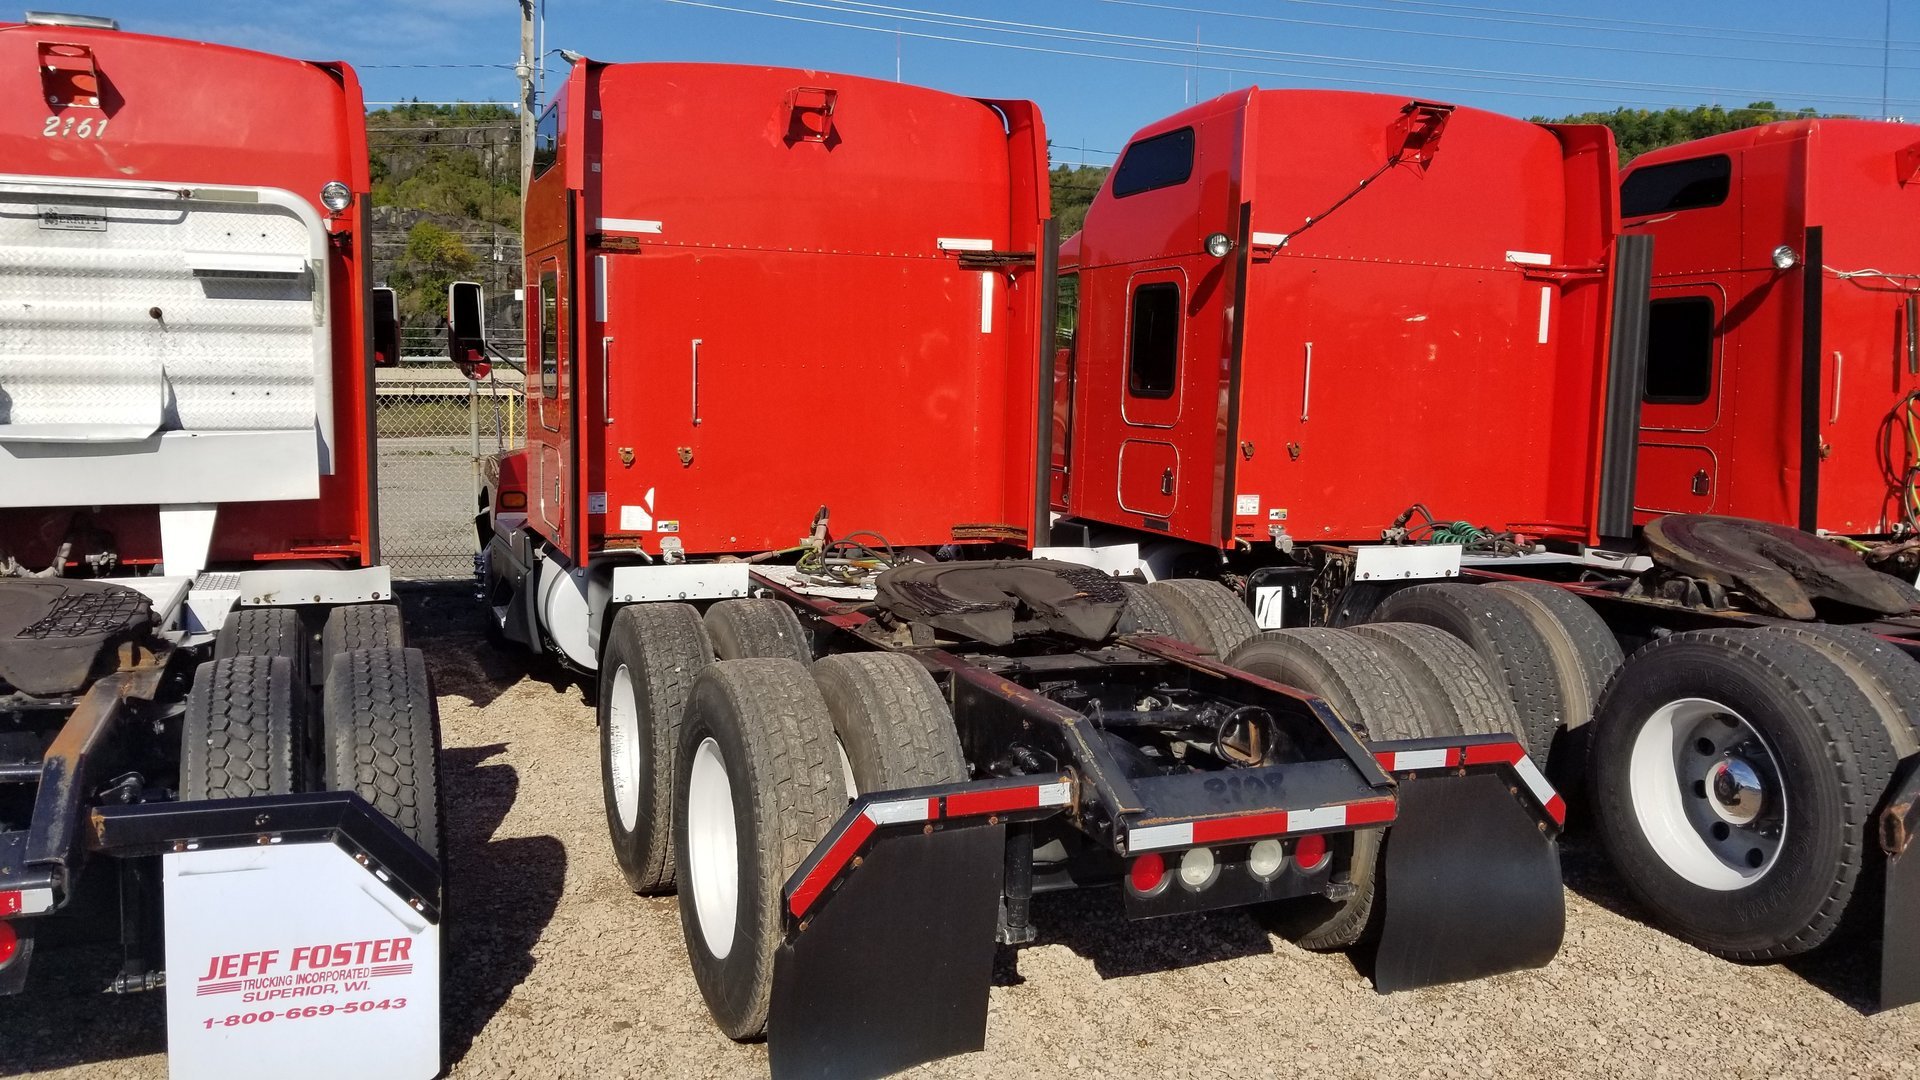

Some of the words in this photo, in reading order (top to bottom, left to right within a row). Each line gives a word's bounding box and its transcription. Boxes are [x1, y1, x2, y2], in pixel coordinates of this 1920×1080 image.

[43, 116, 108, 139] 2161
[1734, 833, 1810, 922] OKOHAMA
[198, 949, 279, 982] JEFF
[289, 937, 413, 972] FOSTER
[242, 973, 293, 991] TRUCKING
[295, 967, 370, 985] INCORPORATED
[242, 983, 339, 1003] SUPERIOR,
[344, 980, 371, 993] WI.
[202, 997, 408, 1030] 1-800-669-5043
